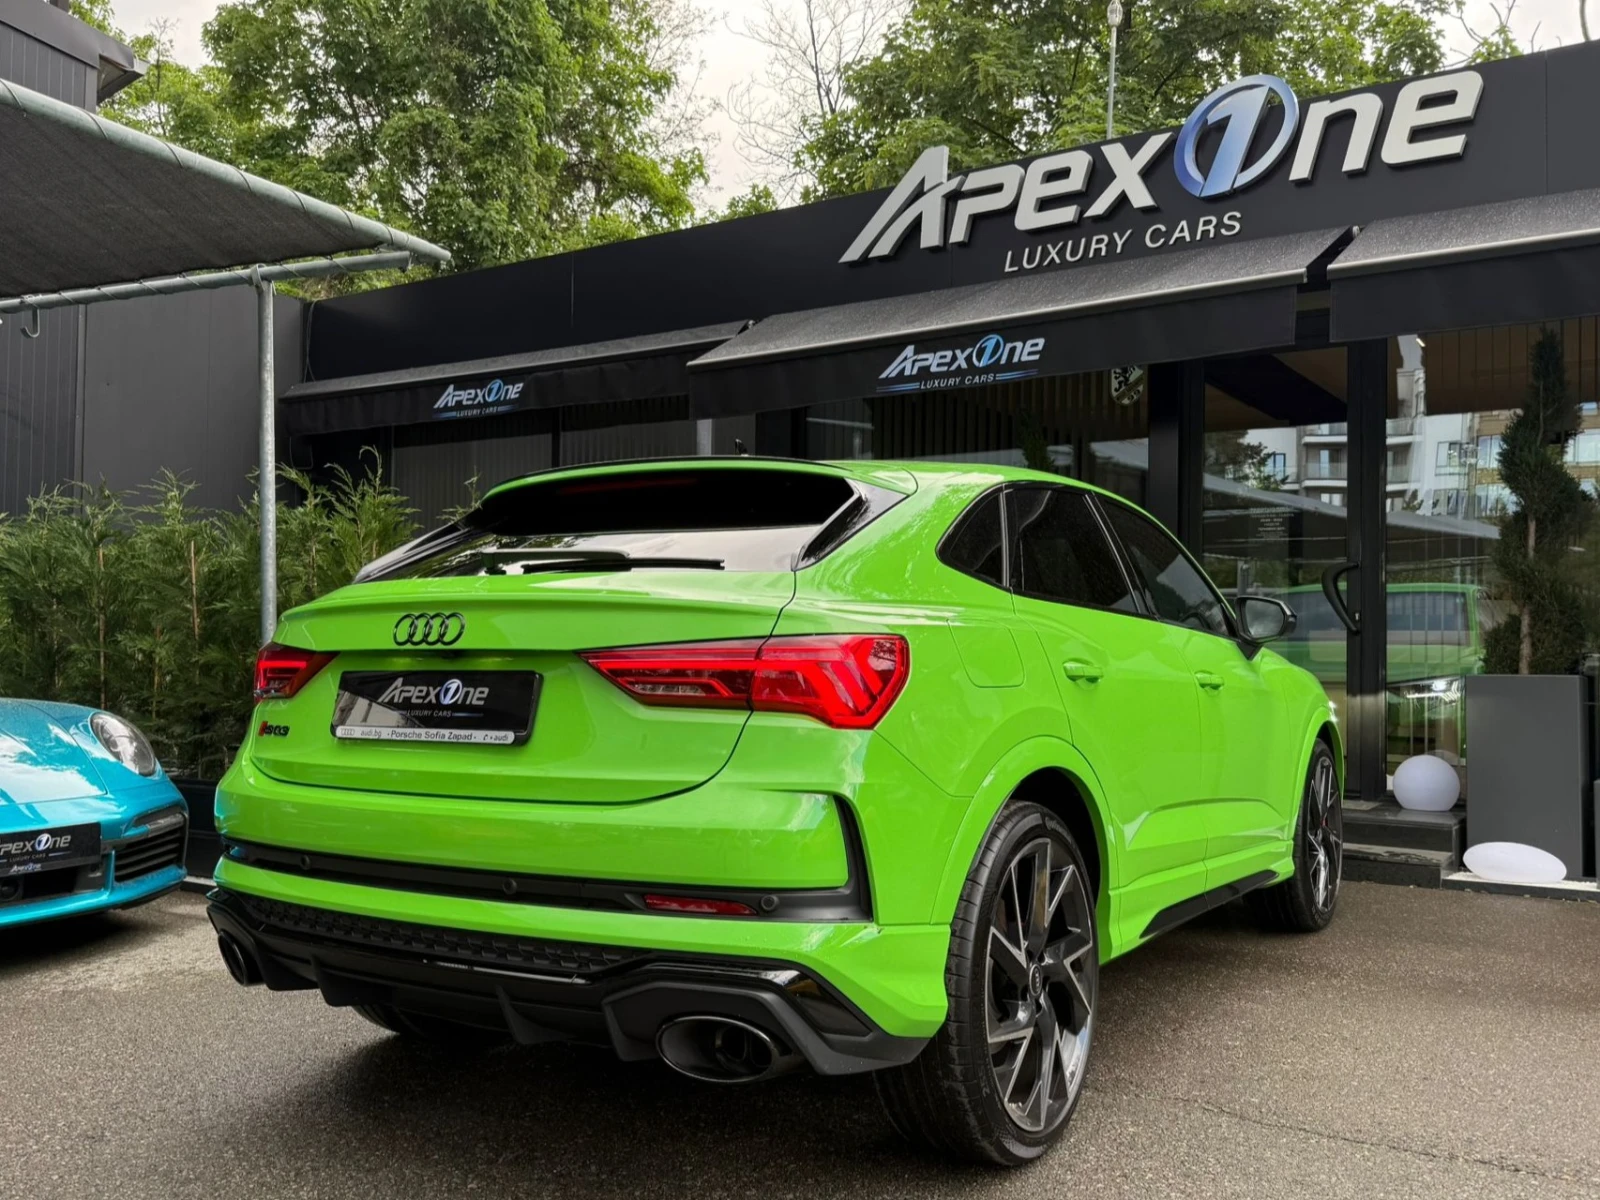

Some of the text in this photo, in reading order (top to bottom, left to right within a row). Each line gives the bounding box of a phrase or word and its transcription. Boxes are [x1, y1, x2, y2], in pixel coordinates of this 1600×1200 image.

[1004, 211, 1242, 273] LUXURY CARS
[920, 373, 994, 389] LUXURY CARS
[456, 406, 497, 417] LUXURY CARS
[433, 710, 452, 718] CARS
[360, 728, 382, 739] audi.bg
[391, 730, 422, 739] Porsche
[424, 731, 446, 740] Sofia
[447, 732, 473, 742] Zapad
